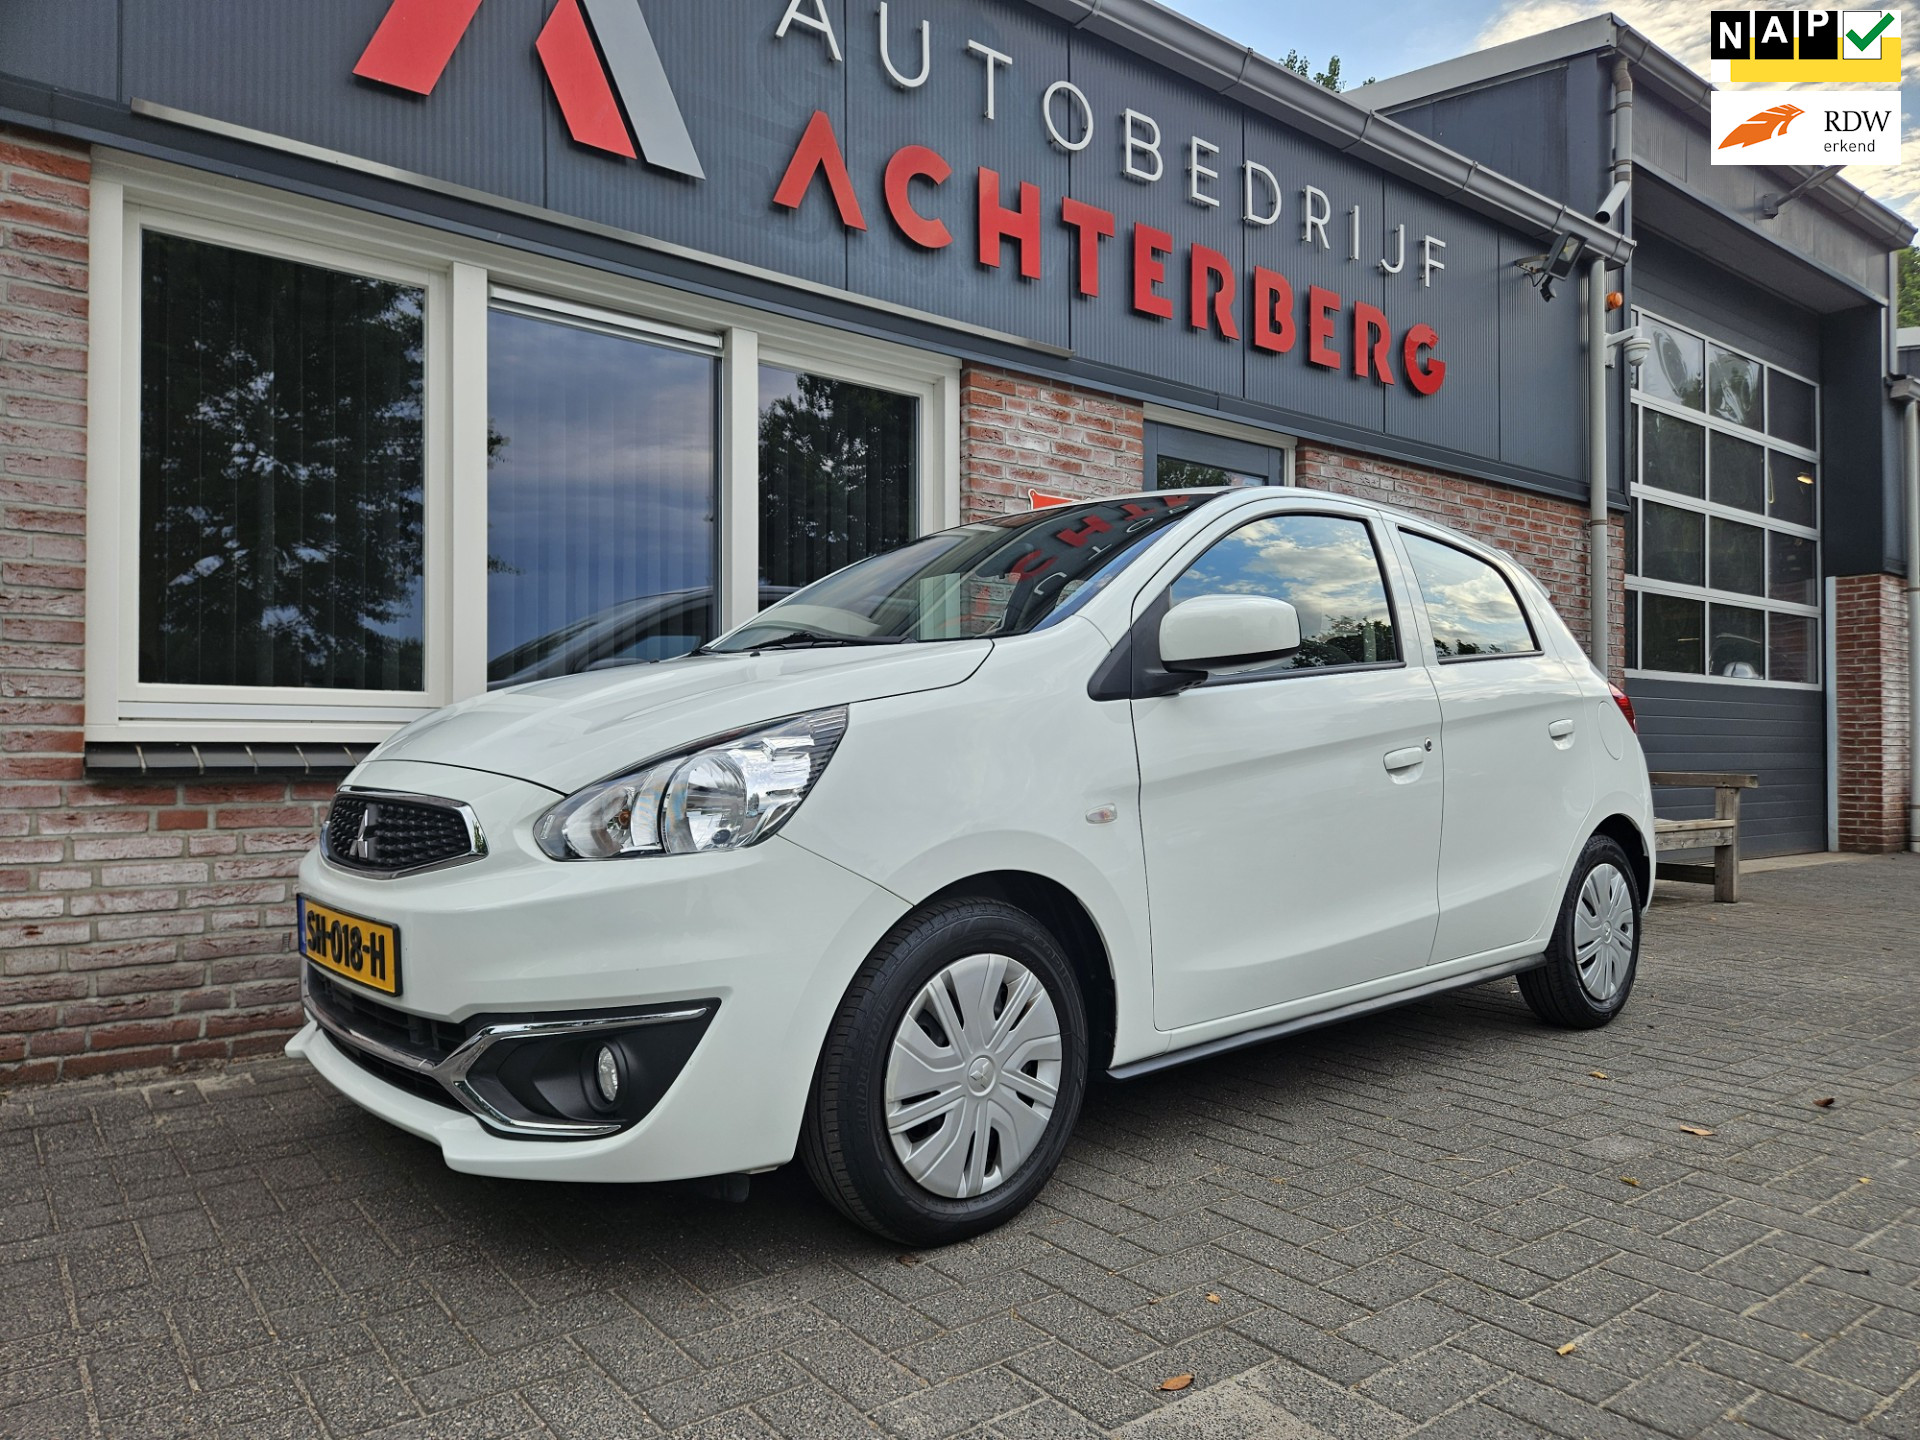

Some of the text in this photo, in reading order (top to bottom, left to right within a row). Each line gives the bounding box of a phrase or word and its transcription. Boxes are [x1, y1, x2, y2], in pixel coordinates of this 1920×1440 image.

[773, 110, 1446, 395] ACHTERBERG
[775, 0, 1446, 287] AUTOBEDRIJF
[307, 910, 386, 981] SH-018-H
